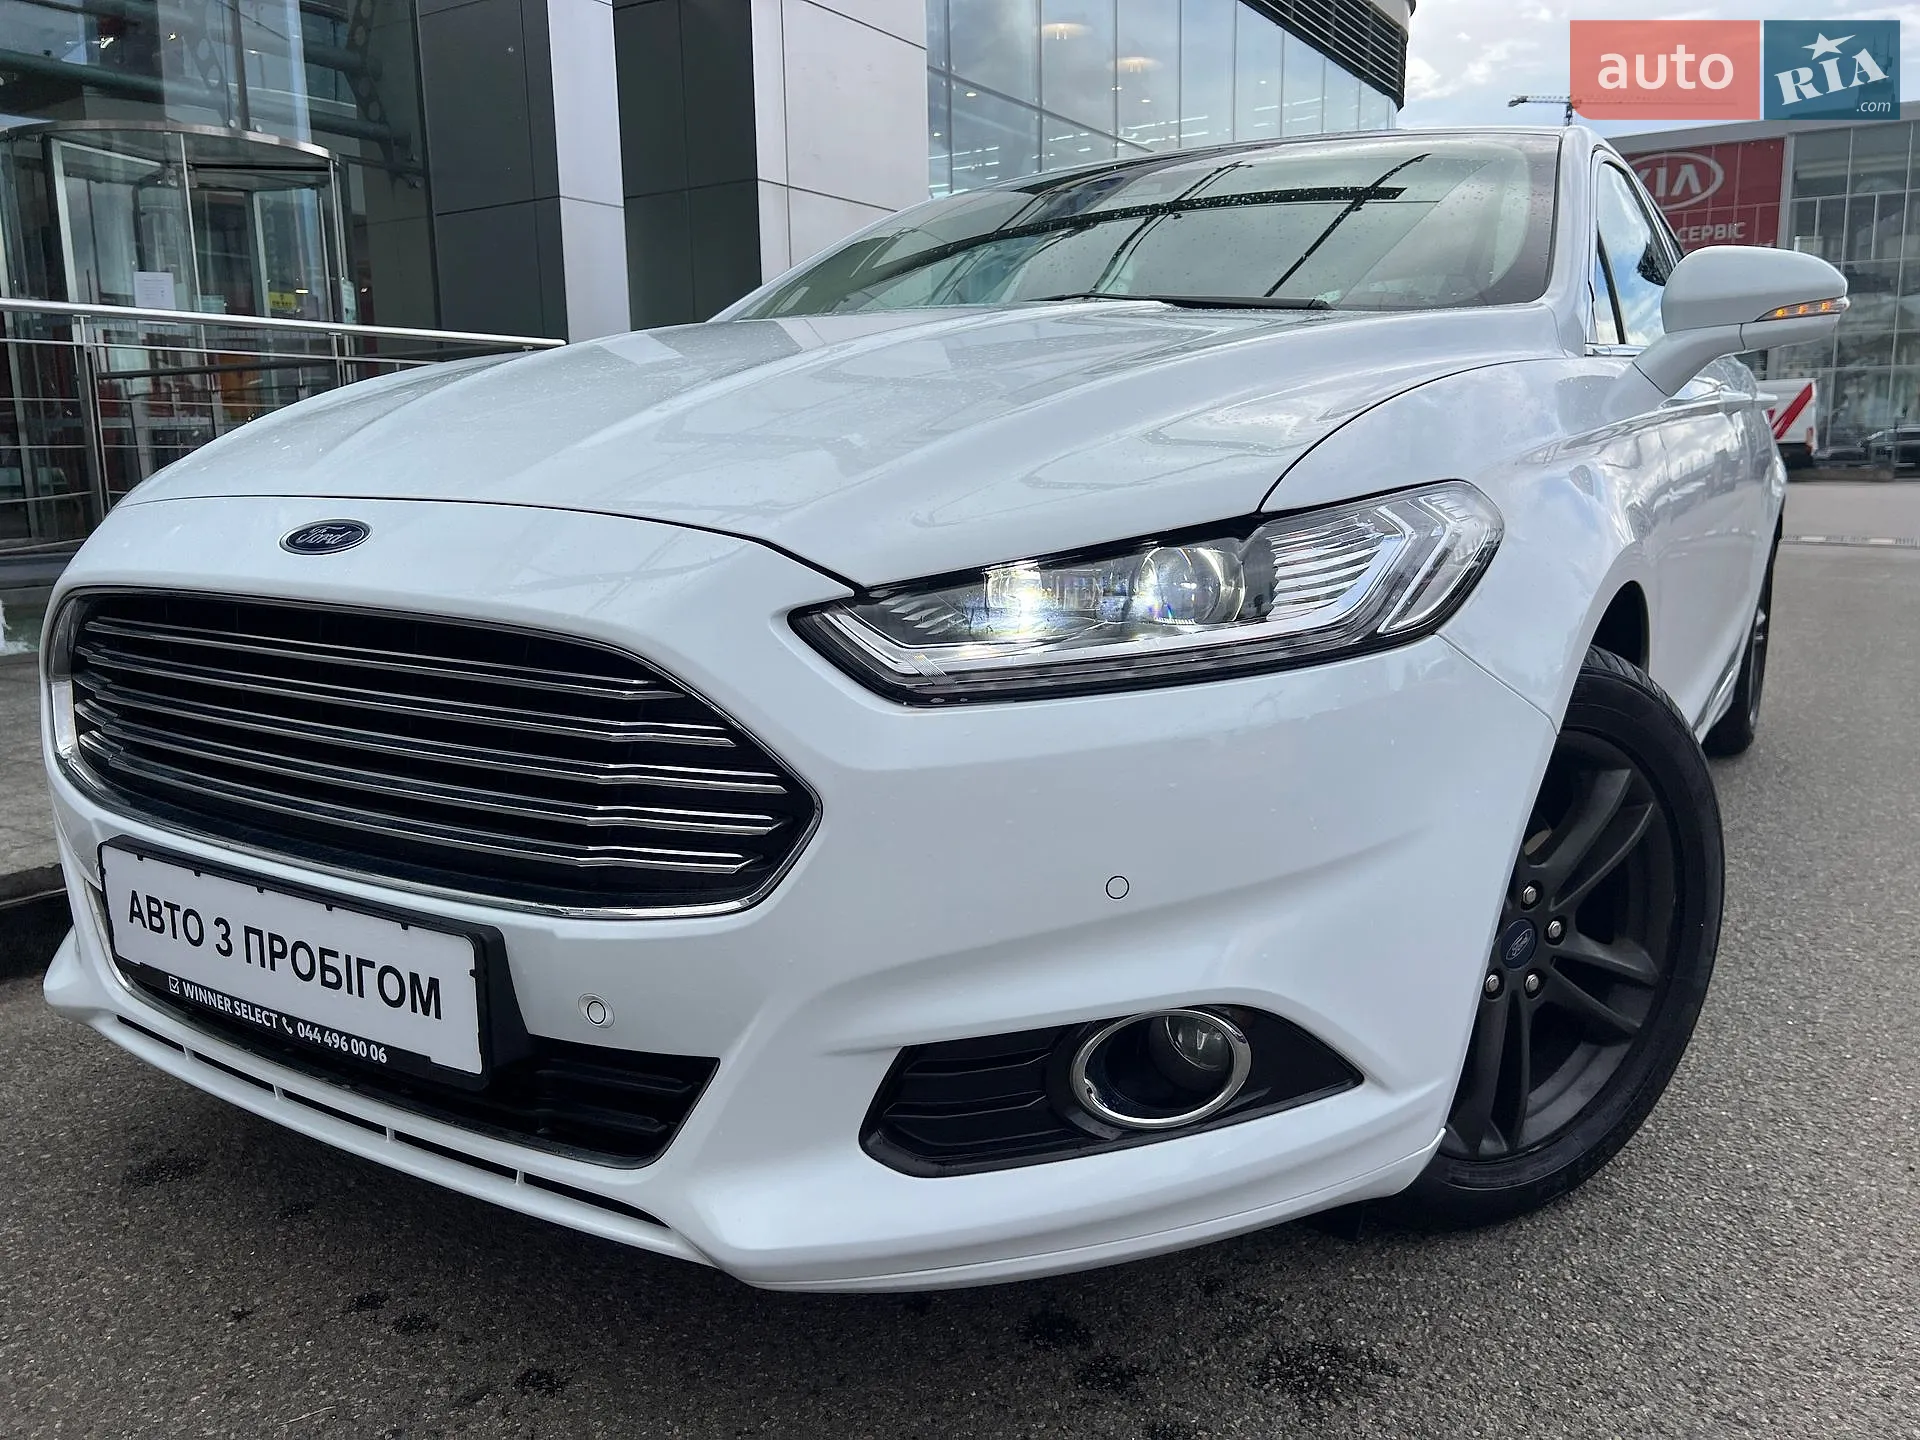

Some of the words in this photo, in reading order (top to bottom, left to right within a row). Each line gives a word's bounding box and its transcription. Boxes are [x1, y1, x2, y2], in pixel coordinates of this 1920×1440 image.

[1677, 221, 1747, 243] СЕРВІС
[295, 525, 352, 545] Ford
[129, 889, 204, 947] АВТО
[243, 925, 443, 1021] ПРОБІГОМ
[182, 981, 233, 1014] WINNER
[234, 1000, 278, 1029] SELECT
[297, 1021, 322, 1044] 044
[324, 1030, 349, 1052] 496
[351, 1038, 368, 1058] 00
[369, 1043, 388, 1064] 06
